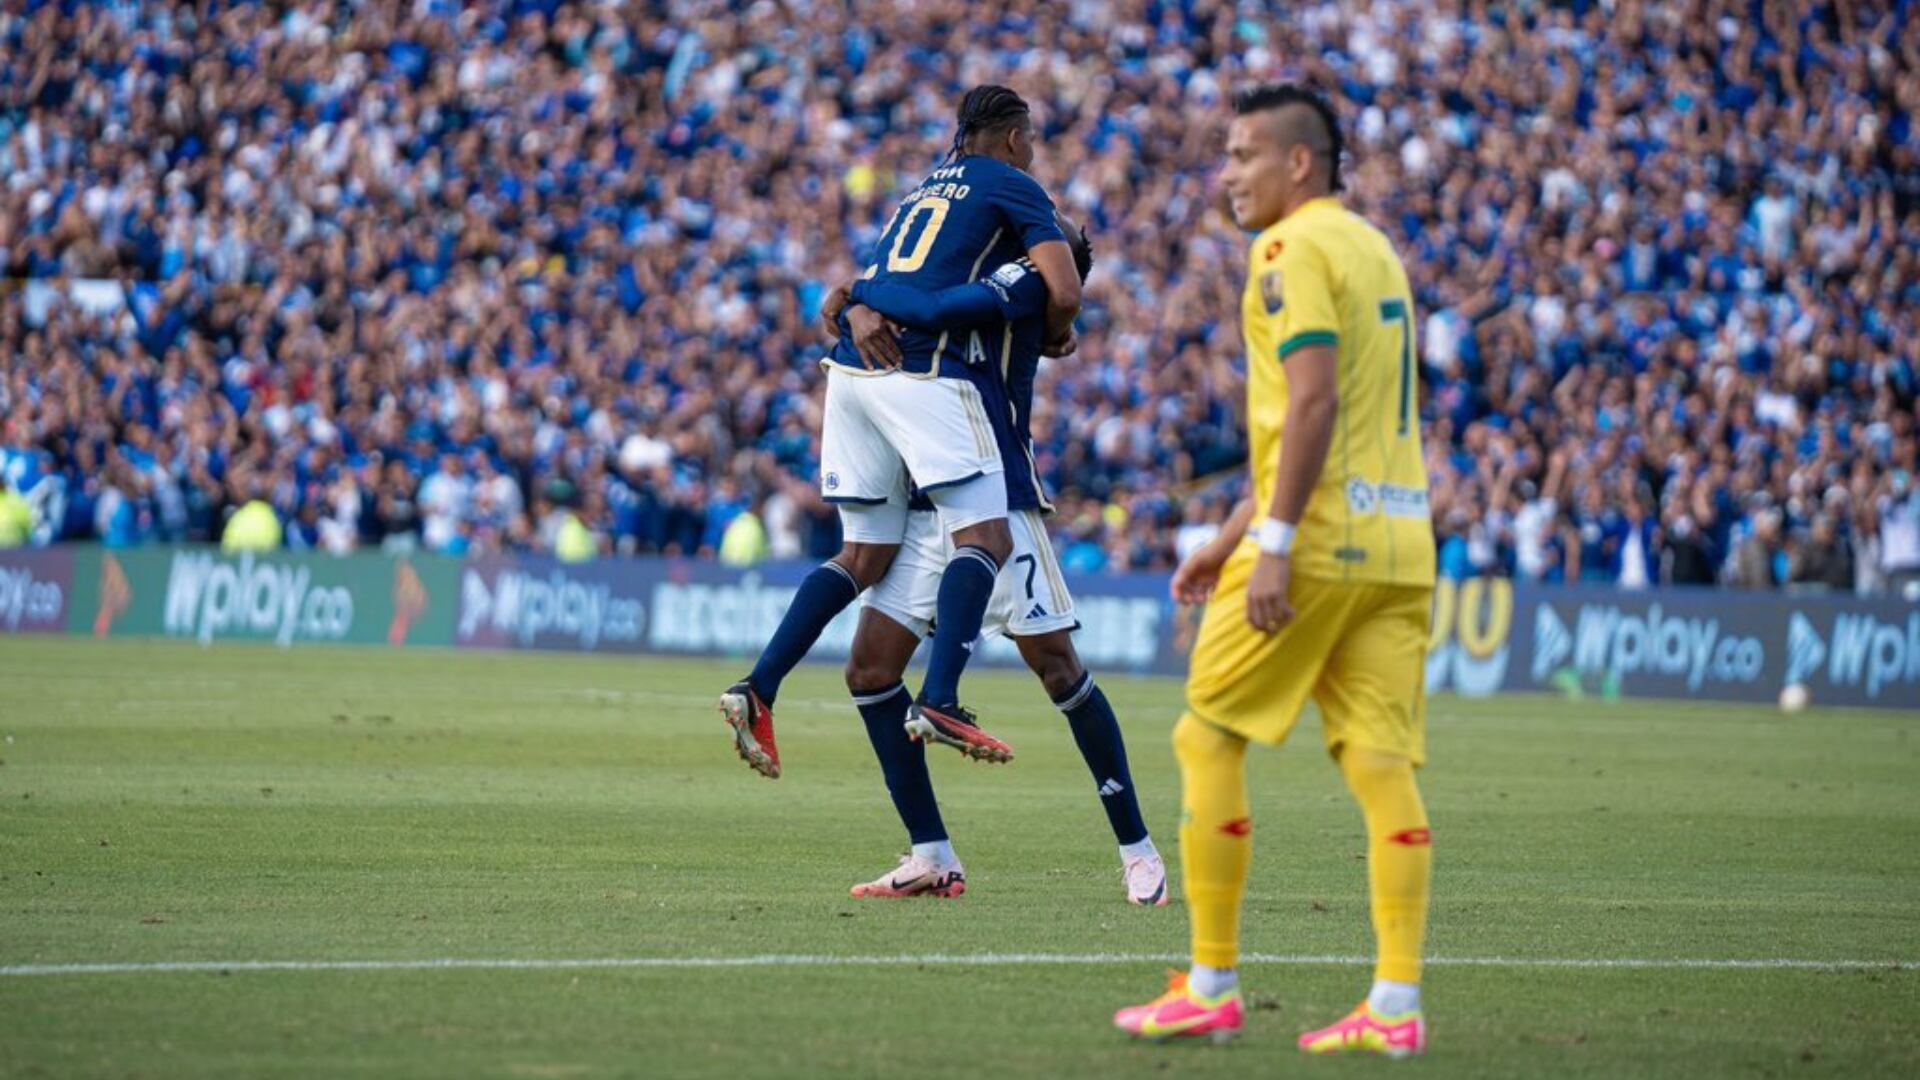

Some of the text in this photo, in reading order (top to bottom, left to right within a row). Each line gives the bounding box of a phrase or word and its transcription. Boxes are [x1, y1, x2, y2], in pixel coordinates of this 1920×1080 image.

[1379, 299, 1410, 438] 7
[164, 548, 354, 648] Wplay.co
[494, 569, 646, 648] Wplay.co
[1015, 553, 1036, 599] 7
[1575, 602, 1764, 692] Wplay.co
